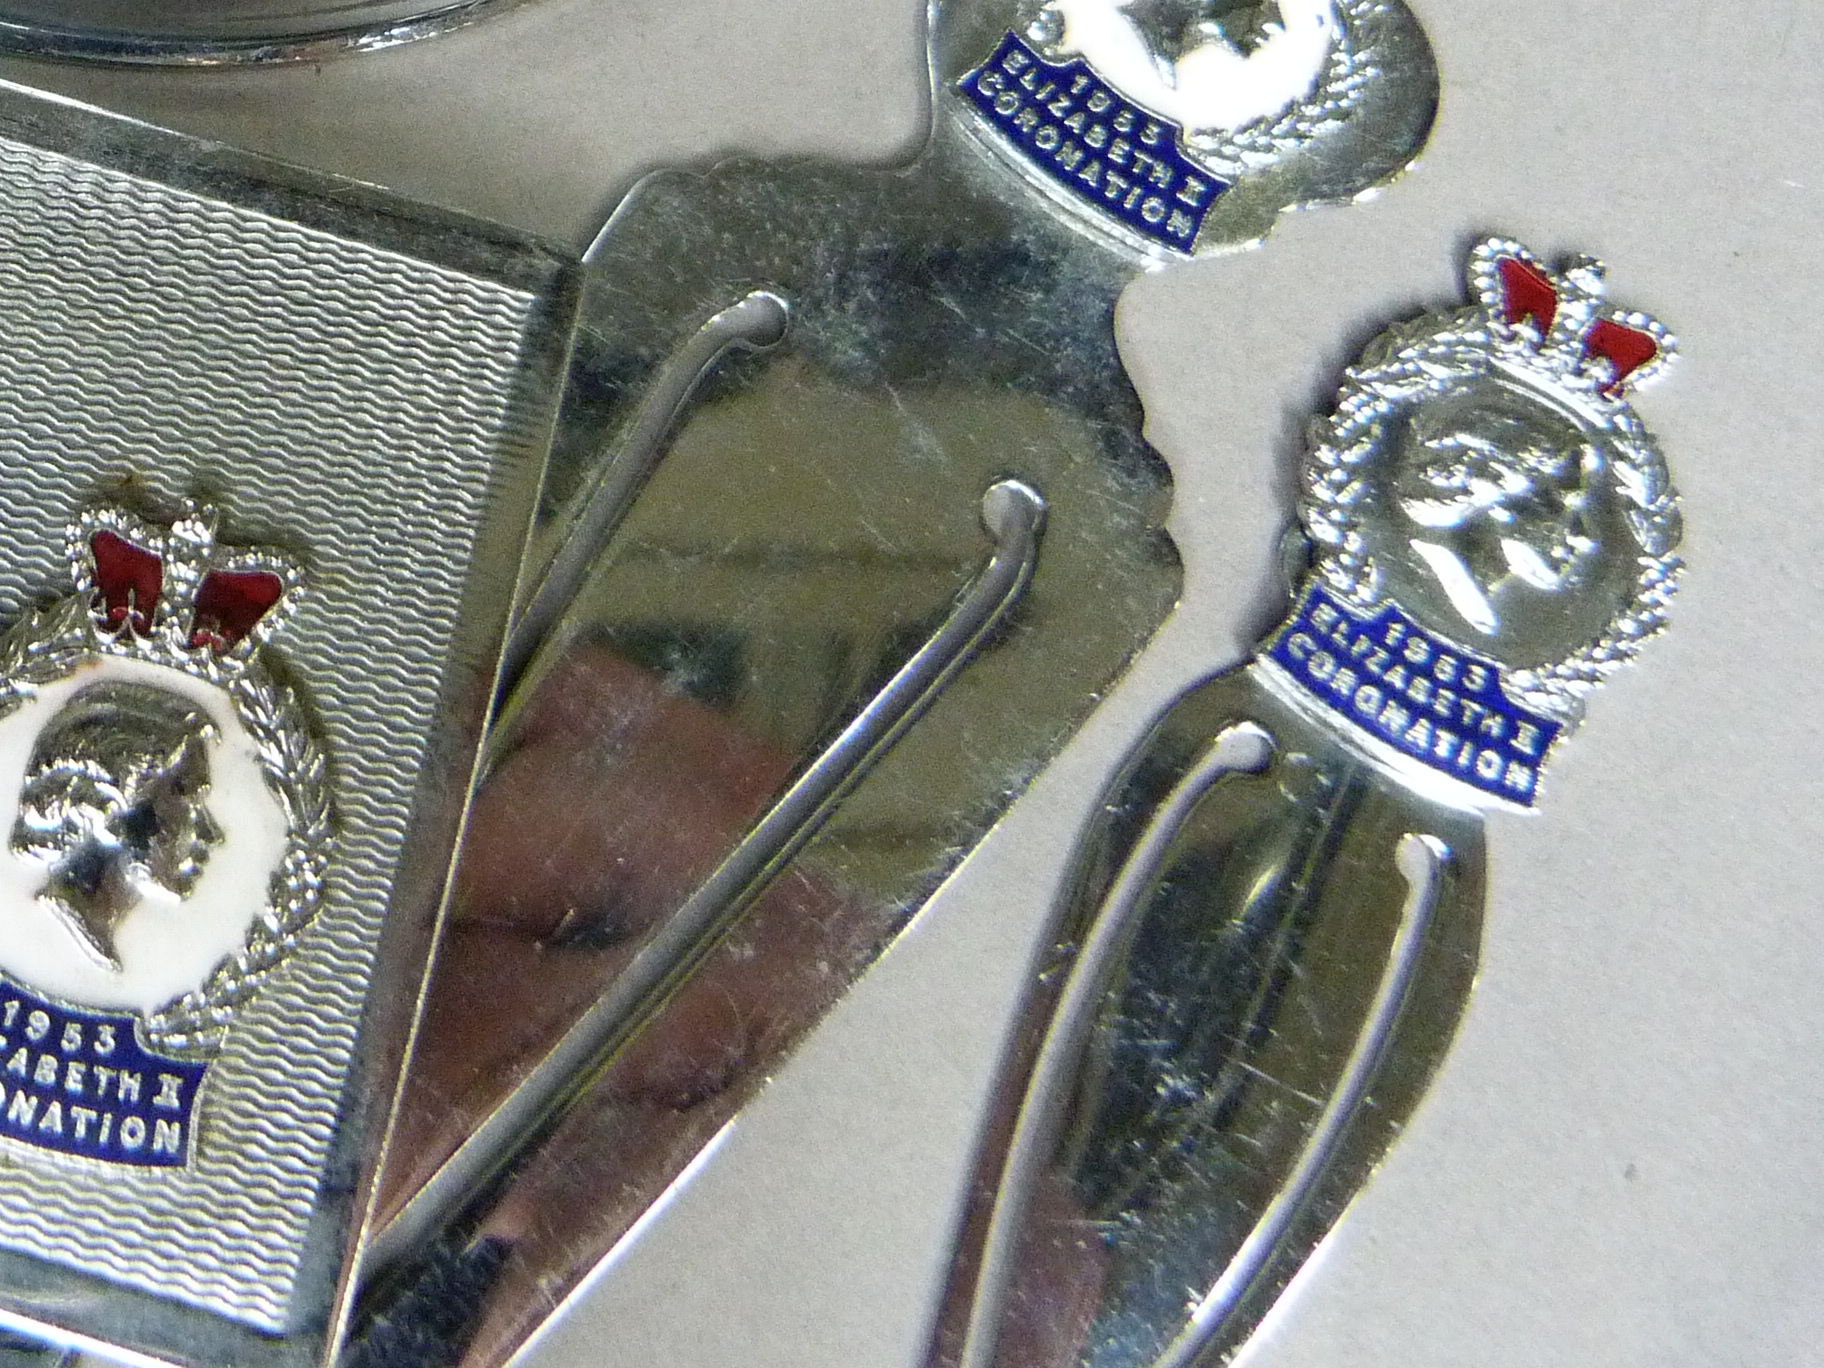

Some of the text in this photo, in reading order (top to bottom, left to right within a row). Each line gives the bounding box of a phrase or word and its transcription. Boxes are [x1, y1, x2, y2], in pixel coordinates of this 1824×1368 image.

[977, 70, 1193, 237] CORONATION
[1002, 49, 1174, 189] ELIZABETH
[1070, 74, 1161, 145] 1953
[1287, 632, 1534, 792] CORONATION
[1310, 602, 1506, 738] ELIZABETH
[1384, 621, 1489, 693] 1953
[1, 999, 116, 1056] 1953
